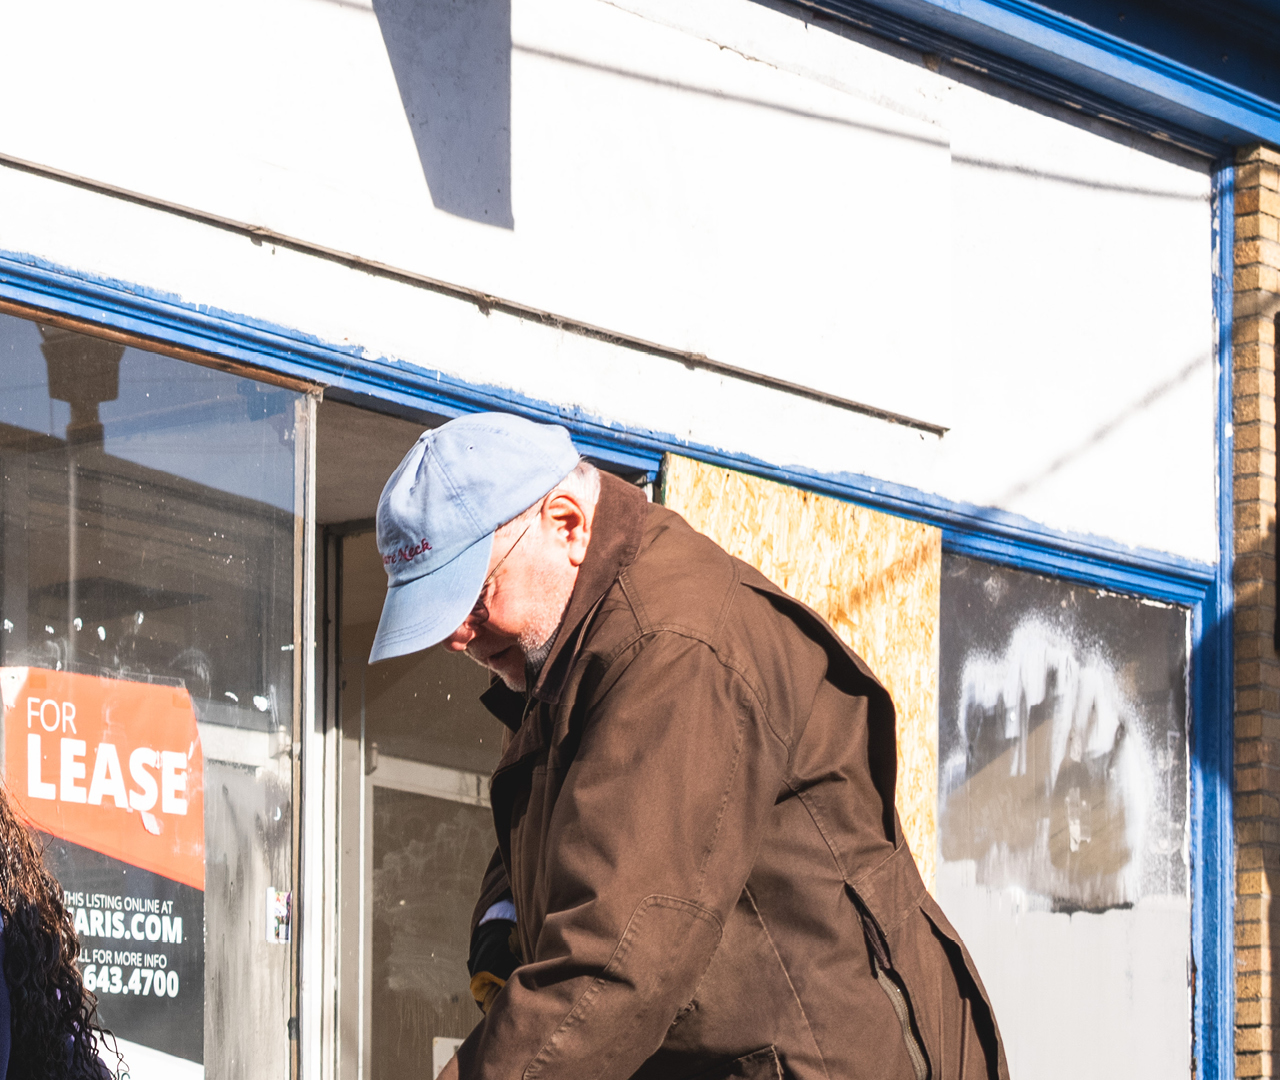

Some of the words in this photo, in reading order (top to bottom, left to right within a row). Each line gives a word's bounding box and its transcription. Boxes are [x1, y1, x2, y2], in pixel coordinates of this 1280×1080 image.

[397, 538, 433, 562] Neck
[27, 696, 77, 735] FOR
[27, 732, 188, 815] LEASE
[64, 890, 84, 907] THIS
[86, 893, 122, 912] LISTING
[124, 896, 160, 914] ONLINE
[161, 900, 174, 915] AT
[69, 907, 183, 944] ARIS.COM
[92, 949, 112, 964] FOR
[114, 951, 142, 967] MORE
[144, 953, 168, 969] INFO
[83, 964, 180, 998] 643.4700
